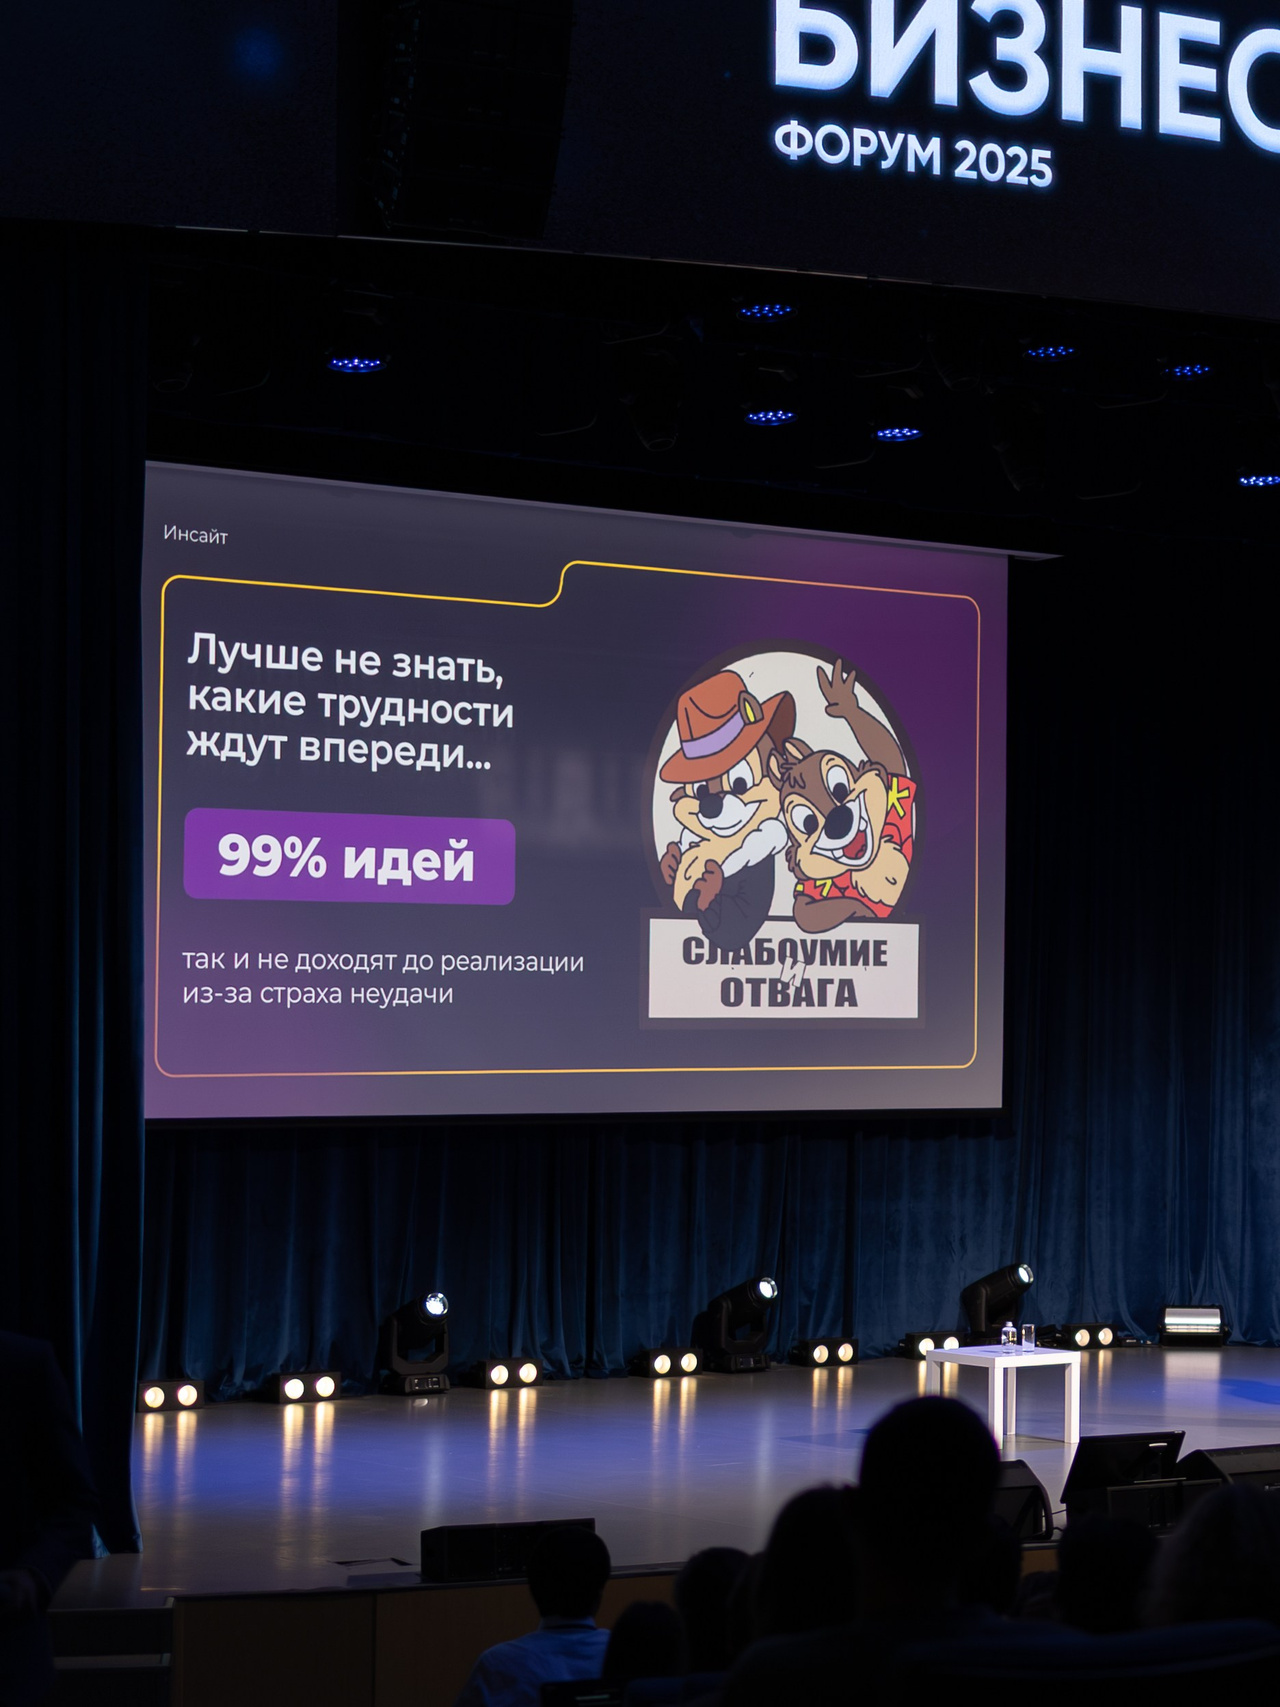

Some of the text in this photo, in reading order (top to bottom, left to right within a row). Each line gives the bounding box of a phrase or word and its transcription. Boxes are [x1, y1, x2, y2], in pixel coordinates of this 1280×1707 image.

[774, 119, 1054, 188] ФОРУМ 2025
[164, 524, 229, 545] Инсайт
[188, 632, 504, 689] Лучше не знать,
[188, 684, 514, 728] какие трудности
[186, 730, 492, 772] ждут впереди...
[218, 833, 475, 886] 99% идей
[182, 950, 585, 975] так и не доходят до реализации
[182, 984, 454, 1009] из-за страха неудачи
[720, 977, 859, 1008] ОТВАГА
